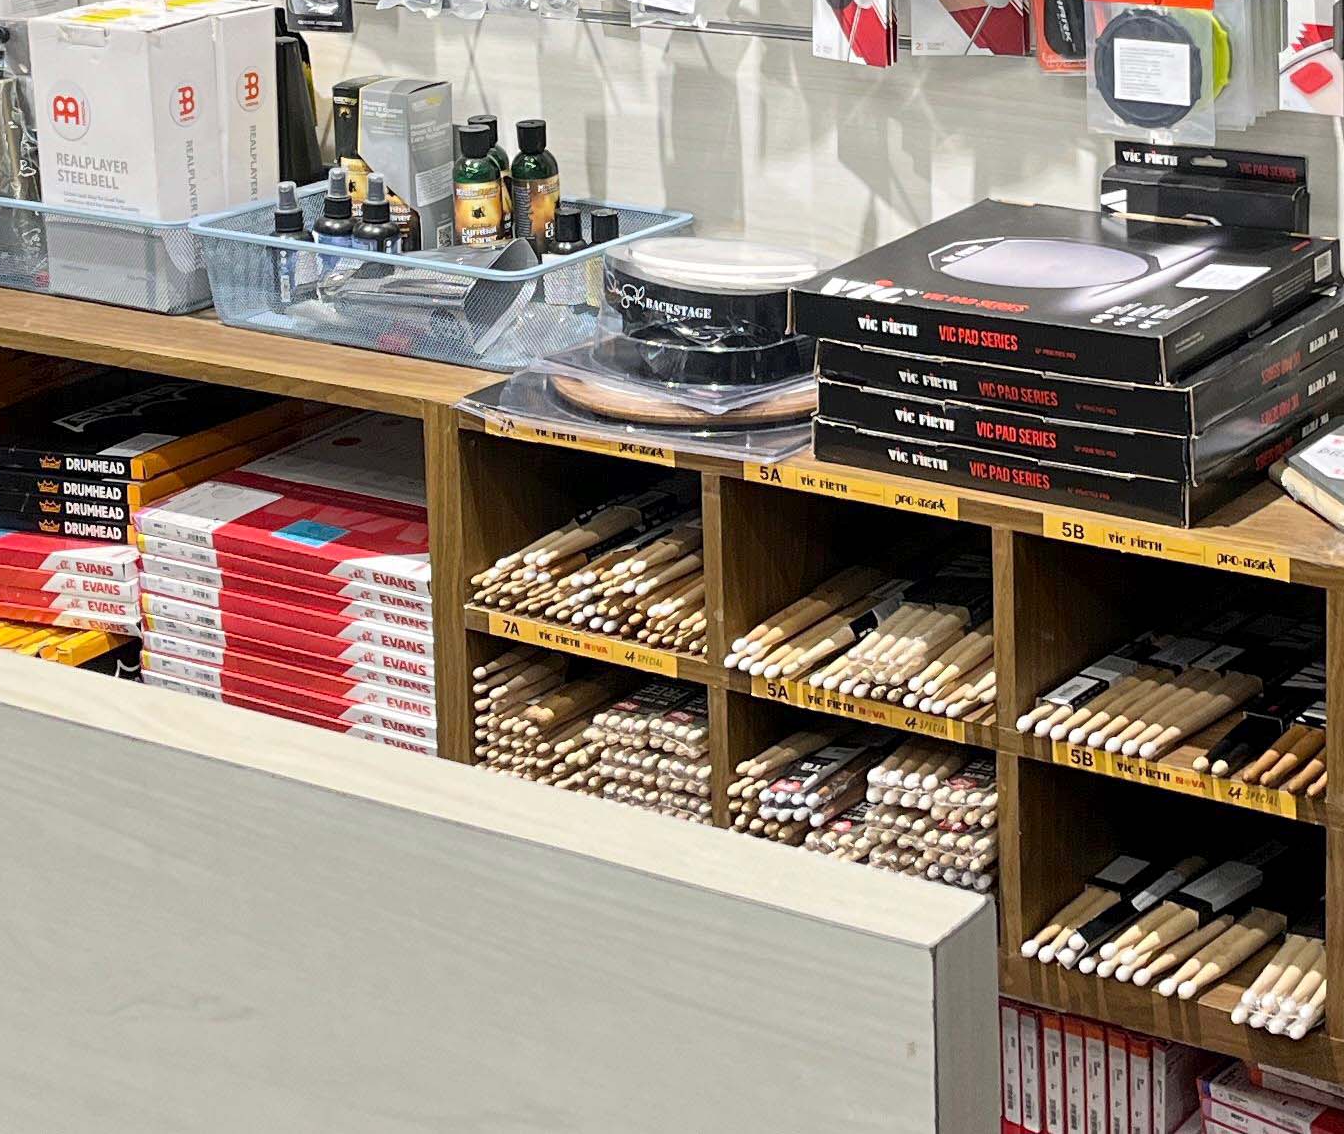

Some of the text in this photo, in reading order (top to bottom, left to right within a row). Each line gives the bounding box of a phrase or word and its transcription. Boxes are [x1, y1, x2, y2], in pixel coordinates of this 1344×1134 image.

[56, 152, 129, 174] REALPLAYER
[185, 140, 198, 207] REALPLAYER
[57, 171, 120, 192] STEELBELL
[462, 226, 496, 236] Cymbal
[645, 297, 711, 320] BACKSTAGE
[938, 324, 957, 343] VIC
[959, 326, 980, 347] PAD
[981, 332, 1018, 351] SERIES
[977, 381, 996, 398] VIC
[998, 384, 1019, 402] PAD
[1021, 387, 1058, 407] SERIES
[976, 421, 995, 438] VIC
[997, 424, 1017, 442] PAD
[1019, 427, 1056, 448] SERIES
[65, 457, 125, 477] DRUMHEAD
[759, 466, 781, 484] 5A
[969, 461, 988, 479] VIC
[990, 464, 1010, 484] PAD
[1012, 468, 1050, 490] SERIES
[63, 481, 122, 500] DRUMHEAD
[65, 502, 124, 521] DRUMHEAD
[63, 521, 122, 540] DRUMHEAD
[1062, 522, 1085, 540] 5B
[75, 561, 114, 577] EVANS
[81, 580, 120, 596] EVANS
[372, 572, 416, 594] EVANS
[87, 600, 126, 616] EVANS
[383, 610, 429, 630] EVANS
[381, 633, 425, 655] EVANS
[502, 620, 520, 637] 7A
[638, 654, 664, 668] SPECIAL
[382, 654, 426, 676] EVANS
[386, 695, 431, 716] EVANS
[767, 682, 789, 701] 5A
[919, 718, 948, 736] SPECIAL
[382, 716, 426, 737] EVANS
[1070, 748, 1094, 768] 5B
[1244, 789, 1278, 806] SPECIAL
